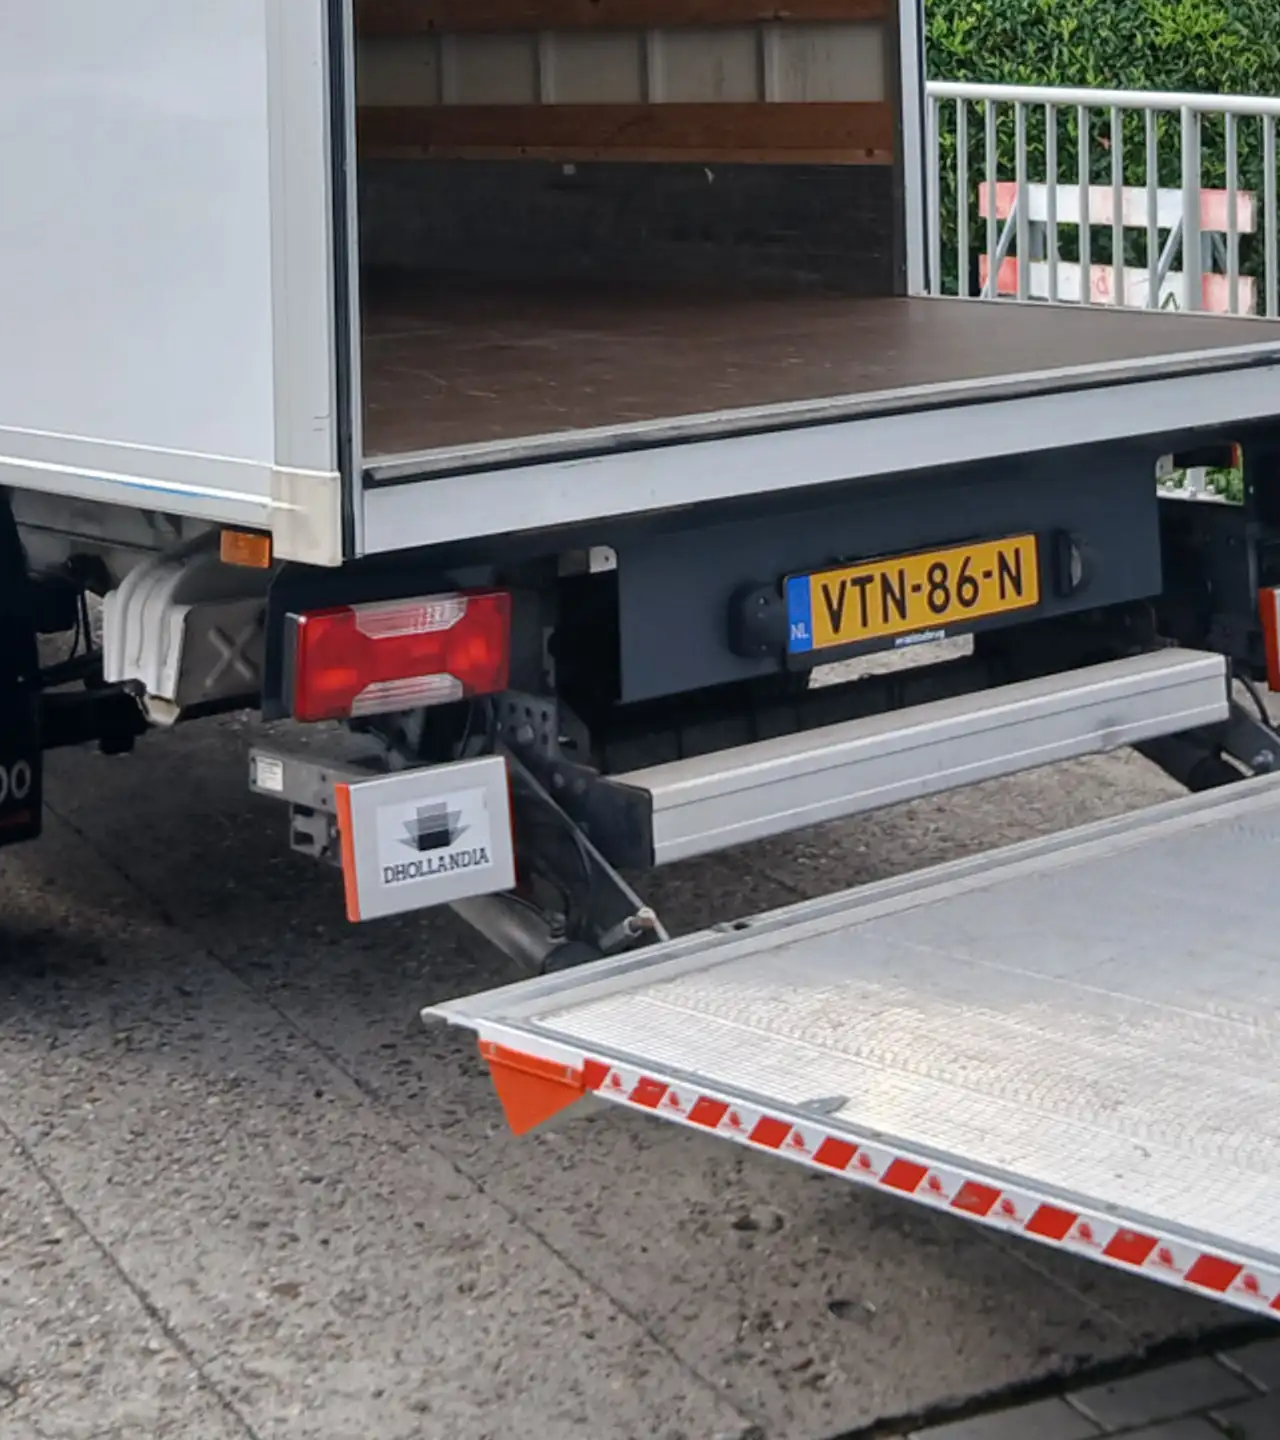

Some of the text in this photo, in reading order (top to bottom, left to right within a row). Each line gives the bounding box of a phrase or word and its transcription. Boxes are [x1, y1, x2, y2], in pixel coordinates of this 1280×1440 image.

[820, 547, 1024, 634] VTN-86-N
[790, 622, 810, 641] NL
[383, 847, 491, 885] DHOLLANDIA
